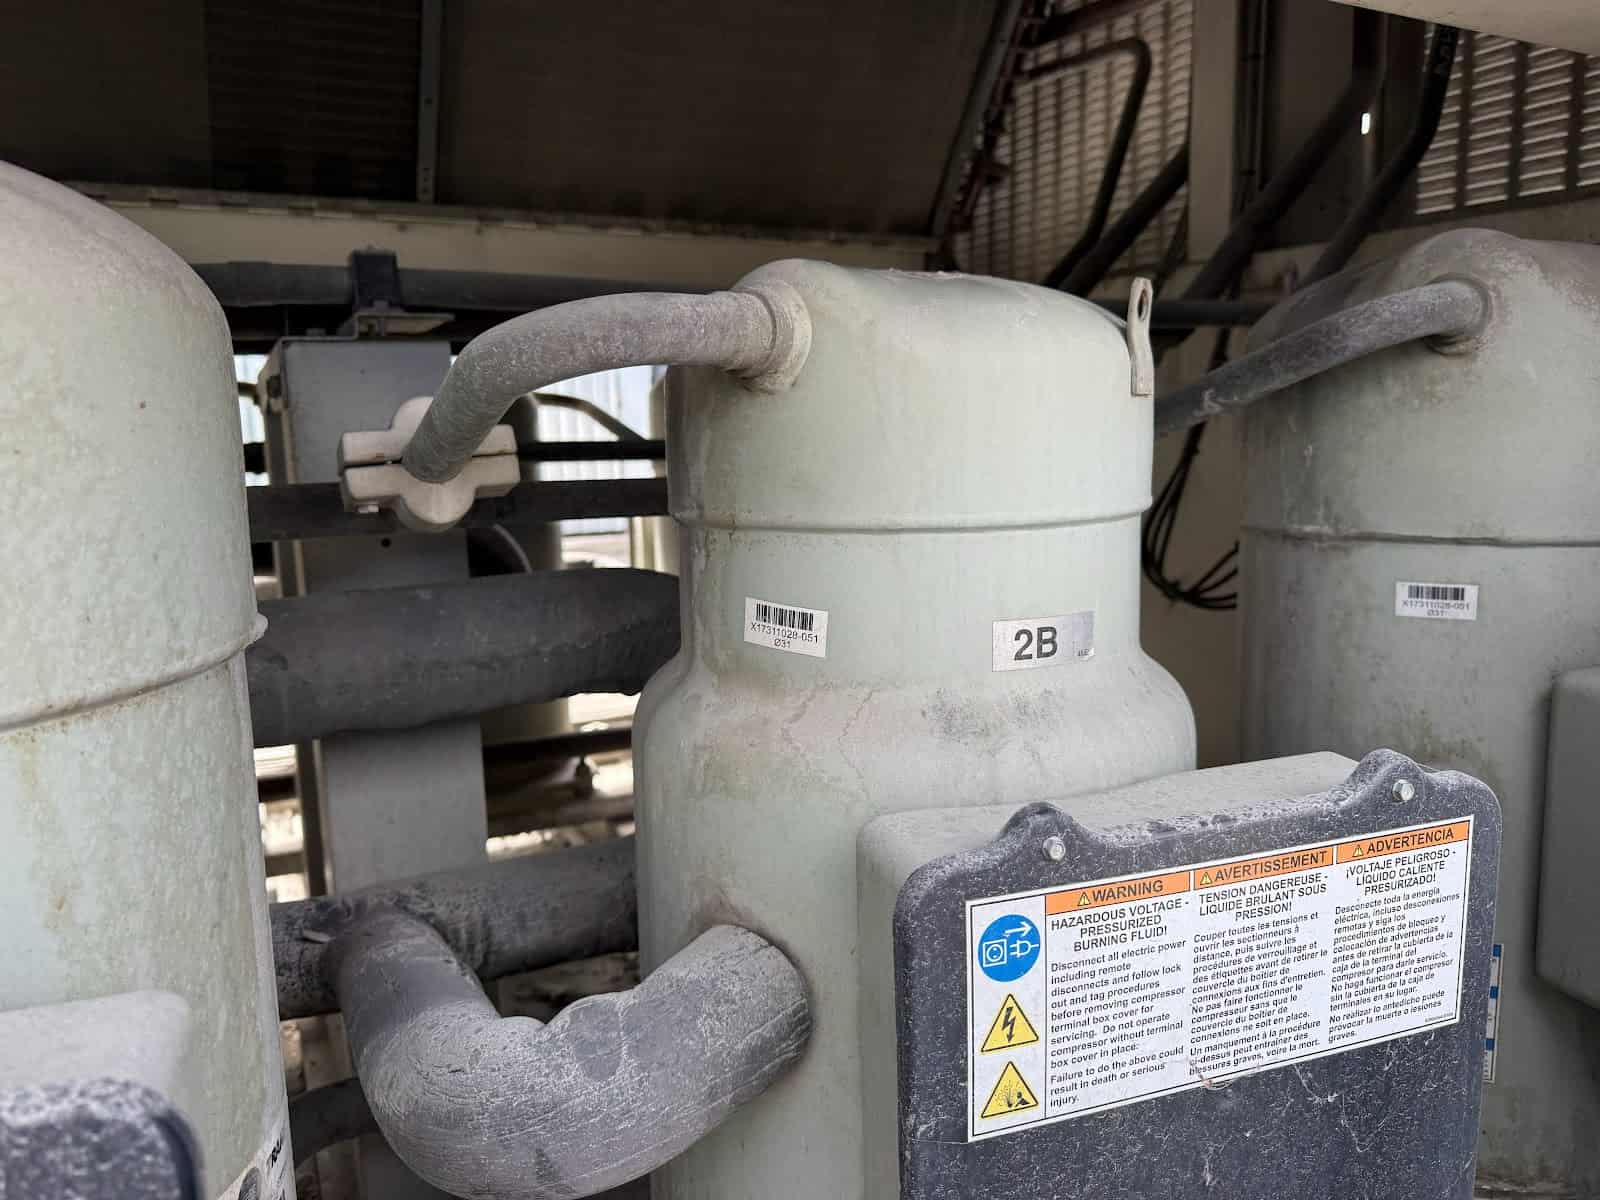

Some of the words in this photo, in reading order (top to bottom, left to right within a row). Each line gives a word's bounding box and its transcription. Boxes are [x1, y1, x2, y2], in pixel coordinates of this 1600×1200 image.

[1014, 626, 1058, 661] 2B
[1367, 828, 1454, 853] ADVERTENCIA
[1215, 851, 1326, 881] AVERTISSEMENT
[1395, 848, 1449, 866] PELIGROSO
[1399, 860, 1444, 877] CALIENTE
[1092, 879, 1163, 902] WARNING
[1199, 886, 1245, 903] TENSION
[1249, 872, 1321, 894] DANGEREUSE
[1364, 873, 1435, 894] PRESURIZADO!
[1200, 899, 1242, 915] LIQUIDE
[1298, 883, 1326, 896] SOUS
[1235, 902, 1291, 920] PRESSION!
[1335, 899, 1381, 914] Desconecte
[1383, 896, 1400, 904] toda
[1373, 906, 1400, 916] incluso
[1403, 894, 1459, 910] desconexiones
[1051, 908, 1125, 930] HAZARDOUS
[1129, 898, 1181, 916] VOLTAGE
[1080, 914, 1160, 937] PRESSURIZED
[1334, 922, 1366, 933] remotas
[1376, 917, 1391, 926] siga
[1074, 933, 1126, 952] BURNING
[1131, 926, 1166, 940] FLUID!
[1193, 941, 1219, 952] ouvrir
[1237, 928, 1291, 944] sectionneurs
[1194, 931, 1225, 942] Couper
[1228, 926, 1254, 935] toutes
[1272, 915, 1307, 927] tensions
[1333, 926, 1394, 945] procedimientos
[1408, 917, 1438, 927] bloqueo
[1390, 926, 1438, 941] advertencias
[1051, 954, 1105, 972] Disconnect
[1108, 951, 1118, 960] all
[1121, 945, 1155, 958] electric
[1158, 940, 1186, 953] power
[1193, 951, 1232, 962] distance,
[1235, 945, 1253, 956] puis
[1256, 940, 1281, 950] suivre
[1256, 959, 1278, 970] avant
[1293, 952, 1318, 962] retirer
[1258, 945, 1306, 959] verrouillage
[1332, 963, 1348, 972] caja
[1372, 951, 1402, 964] terminal
[1405, 948, 1416, 956] del
[1051, 970, 1095, 984] including
[1098, 962, 1130, 974] remote
[1051, 979, 1108, 996] disconnects
[1112, 973, 1128, 984] and
[1132, 969, 1159, 980] follow
[1162, 963, 1180, 973] lock
[1051, 998, 1066, 1008] out
[1070, 994, 1086, 1004] and
[1090, 993, 1104, 1001] tag
[1108, 981, 1159, 999] procedures
[1051, 1009, 1081, 1020] before
[1084, 999, 1128, 1013] removing
[1131, 987, 1185, 1003] compressor
[1192, 988, 1241, 1003] connexions
[1206, 1002, 1221, 1012] pas
[1224, 997, 1242, 1006] faire
[1245, 986, 1293, 1001] fonctionner
[1051, 1017, 1089, 1032] terminal
[1092, 1015, 1109, 1023] box
[1113, 1009, 1138, 1019] cover
[1191, 1006, 1247, 1023] compresseur
[1250, 1001, 1269, 1010] sans
[1272, 997, 1287, 1007] que
[1051, 1030, 1096, 1044] servicing.
[1103, 1025, 1115, 1033] Do
[1118, 1019, 1133, 1029] not
[1136, 1013, 1169, 1027] operate
[1051, 1039, 1107, 1056] compressor
[1110, 1029, 1143, 1043] without
[1146, 1020, 1182, 1035] terminal
[1190, 1027, 1239, 1043] connexions
[1255, 1018, 1271, 1028] soit
[1204, 1033, 1259, 1052] manquement
[1233, 1044, 1251, 1057] peut
[1051, 1059, 1068, 1068] box
[1071, 1053, 1097, 1063] cover
[1051, 1071, 1082, 1083] Failure
[1098, 1064, 1109, 1072] do
[1112, 1060, 1125, 1069] the
[1129, 1054, 1155, 1065] above
[1159, 1046, 1183, 1058] could
[1189, 1060, 1230, 1075] blessures
[1266, 1047, 1286, 1056] voire
[1051, 1082, 1077, 1095] result
[1091, 1072, 1116, 1085] death
[1132, 1063, 1164, 1076] serious
